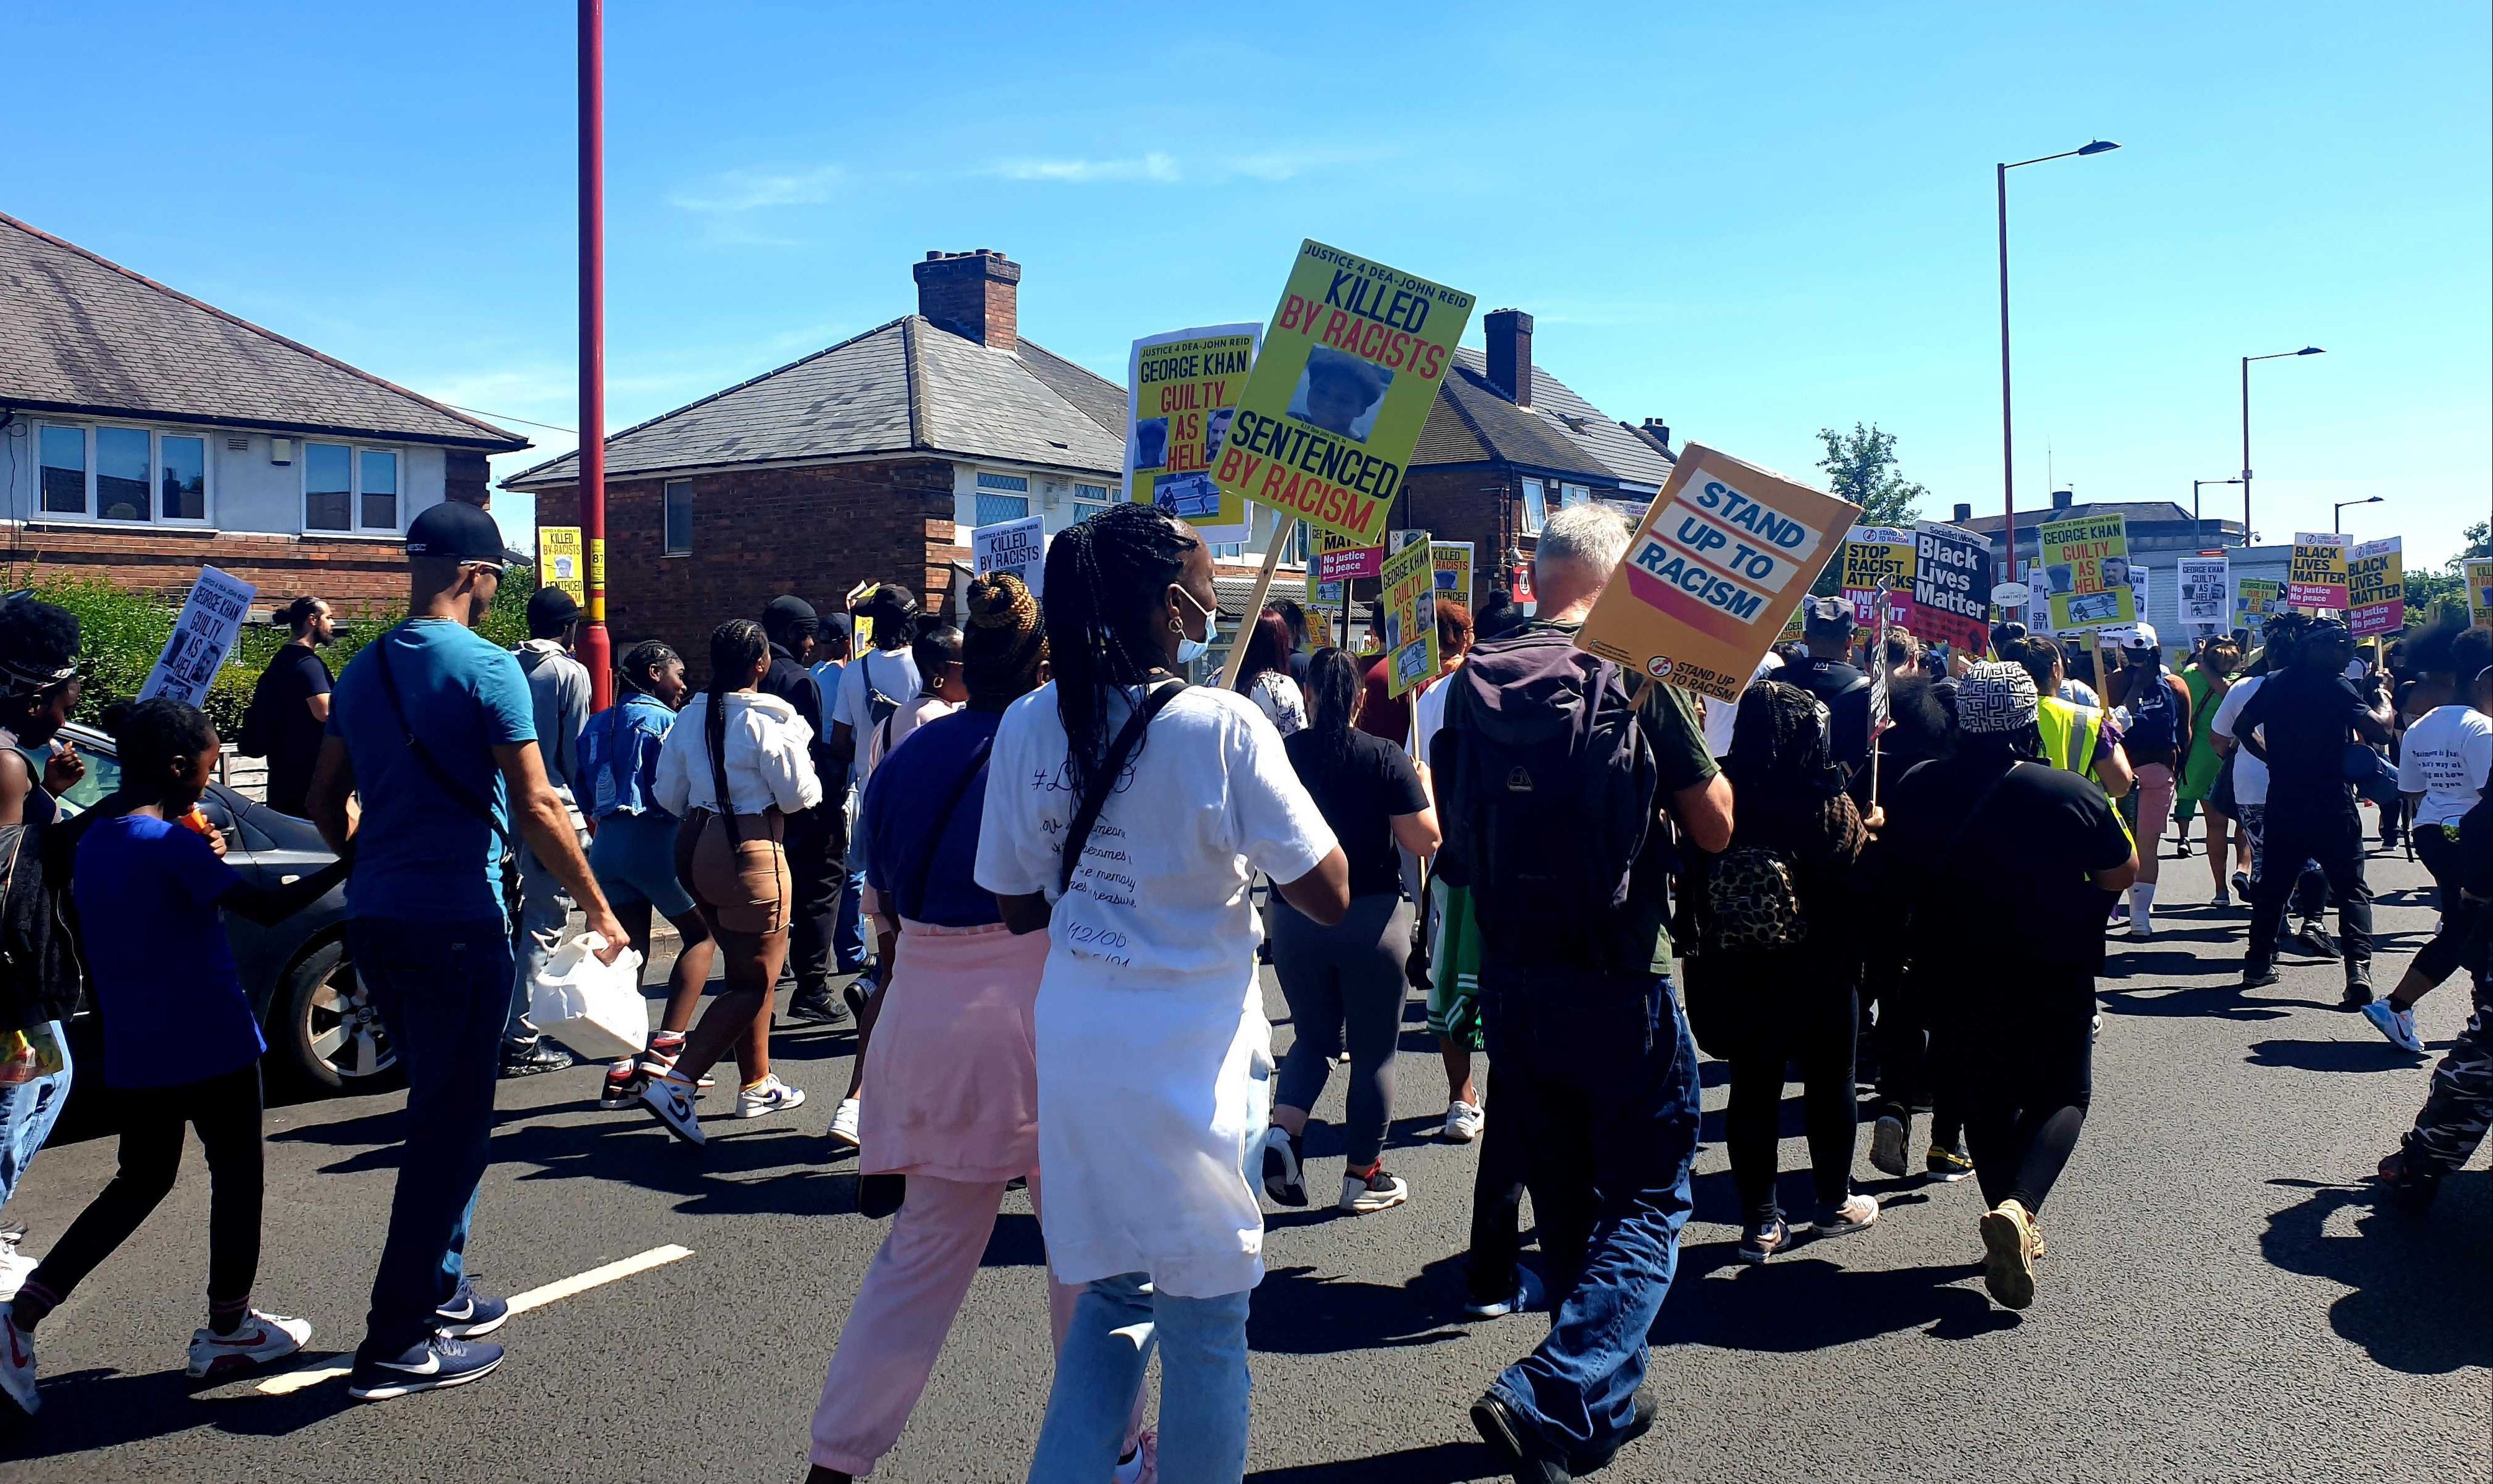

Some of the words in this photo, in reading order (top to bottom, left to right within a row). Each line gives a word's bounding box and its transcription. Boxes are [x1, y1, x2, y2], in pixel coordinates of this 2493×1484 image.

[1304, 245, 1355, 269] JUSTICE
[1357, 263, 1366, 273] 4
[1369, 266, 1436, 297] DEA-JOHN
[1438, 289, 1468, 309] REID
[1324, 269, 1430, 334] KILLED
[1142, 346, 1173, 358] JUSTICE
[1182, 339, 1227, 351] DEA-JOHN
[1230, 337, 1250, 347] REID
[1279, 294, 1324, 335] BY
[1322, 309, 1445, 380] RACISTS
[1141, 355, 1199, 383] GEORGE
[1203, 350, 1248, 376] KHAN
[1161, 381, 1226, 414] GUILTY
[1174, 413, 1199, 441] AS
[1167, 443, 1211, 472] HELL
[1231, 410, 1399, 500] SENTENCED
[1217, 447, 1262, 489] BY
[1260, 463, 1376, 535] RACISM
[1696, 481, 1805, 549] STAND
[550, 533, 573, 545] KILLED
[991, 532, 1027, 554] KILLED
[1887, 536, 1909, 544] RACISM
[1929, 526, 1958, 540] Socialist
[1958, 532, 1981, 547] Worker
[2043, 528, 2087, 545] GEORGE
[2089, 523, 2121, 540] KHAN
[543, 545, 552, 555] BY
[555, 544, 581, 555] RACISTS
[1324, 554, 1335, 564] No
[1335, 551, 1366, 565] justice
[1433, 550, 1460, 561] KILLED
[1677, 516, 1727, 552] UP
[1728, 543, 1774, 579] TO
[1848, 544, 1891, 559] STOP
[1918, 536, 1978, 571] Black
[2062, 541, 2109, 561] GUILTY
[2295, 546, 2338, 559] BLACK
[593, 554, 604, 563] 87
[980, 554, 992, 571] BY
[996, 546, 1039, 568] RACISTS
[1323, 563, 1334, 575] No
[1335, 561, 1361, 575] peace
[1383, 560, 1409, 590] GEORGE
[1410, 547, 1429, 572] KHAN
[1435, 560, 1468, 571] RACISTS
[1848, 558, 1904, 574] RACIST
[2078, 560, 2096, 577] AS
[2294, 558, 2330, 571] LIVES
[2348, 555, 2389, 577] BLACK
[1636, 541, 1763, 619] RACISM
[1917, 558, 1971, 591] Lives
[2131, 575, 2144, 585] HAN
[2192, 574, 2217, 583] GUILTY
[2208, 566, 2225, 574] KHAN
[2292, 570, 2346, 584] MATTER
[545, 581, 583, 592] SENTENCED
[1394, 574, 1422, 608] GUILTY
[1846, 572, 1915, 590] ATTKS
[2033, 584, 2043, 594] BY
[2074, 576, 2107, 595] HELL
[2199, 584, 2209, 592] AS
[2291, 584, 2302, 594] No
[2304, 586, 2331, 594] justice
[2349, 572, 2384, 591] LIVES
[192, 586, 220, 613] GEORGE
[218, 598, 243, 622] KHAN
[1915, 581, 1986, 620] Matter
[2196, 592, 2213, 602] HELL
[2290, 592, 2301, 600] No
[2303, 594, 2327, 602] peace
[2350, 583, 2400, 606] MATTER
[1402, 601, 1412, 624] AS
[2350, 609, 2361, 619] No
[2363, 605, 2389, 618] justice
[2351, 619, 2361, 629] No
[2364, 616, 2386, 626] peace
[189, 610, 224, 641] GUILTY
[1400, 621, 1420, 649] HELL
[184, 635, 202, 658] AS
[173, 656, 196, 684] HELL
[1675, 661, 1716, 682] STAND
[1716, 675, 1736, 687] UP
[1671, 672, 1688, 686] TO
[1687, 678, 1737, 702] RACISM
